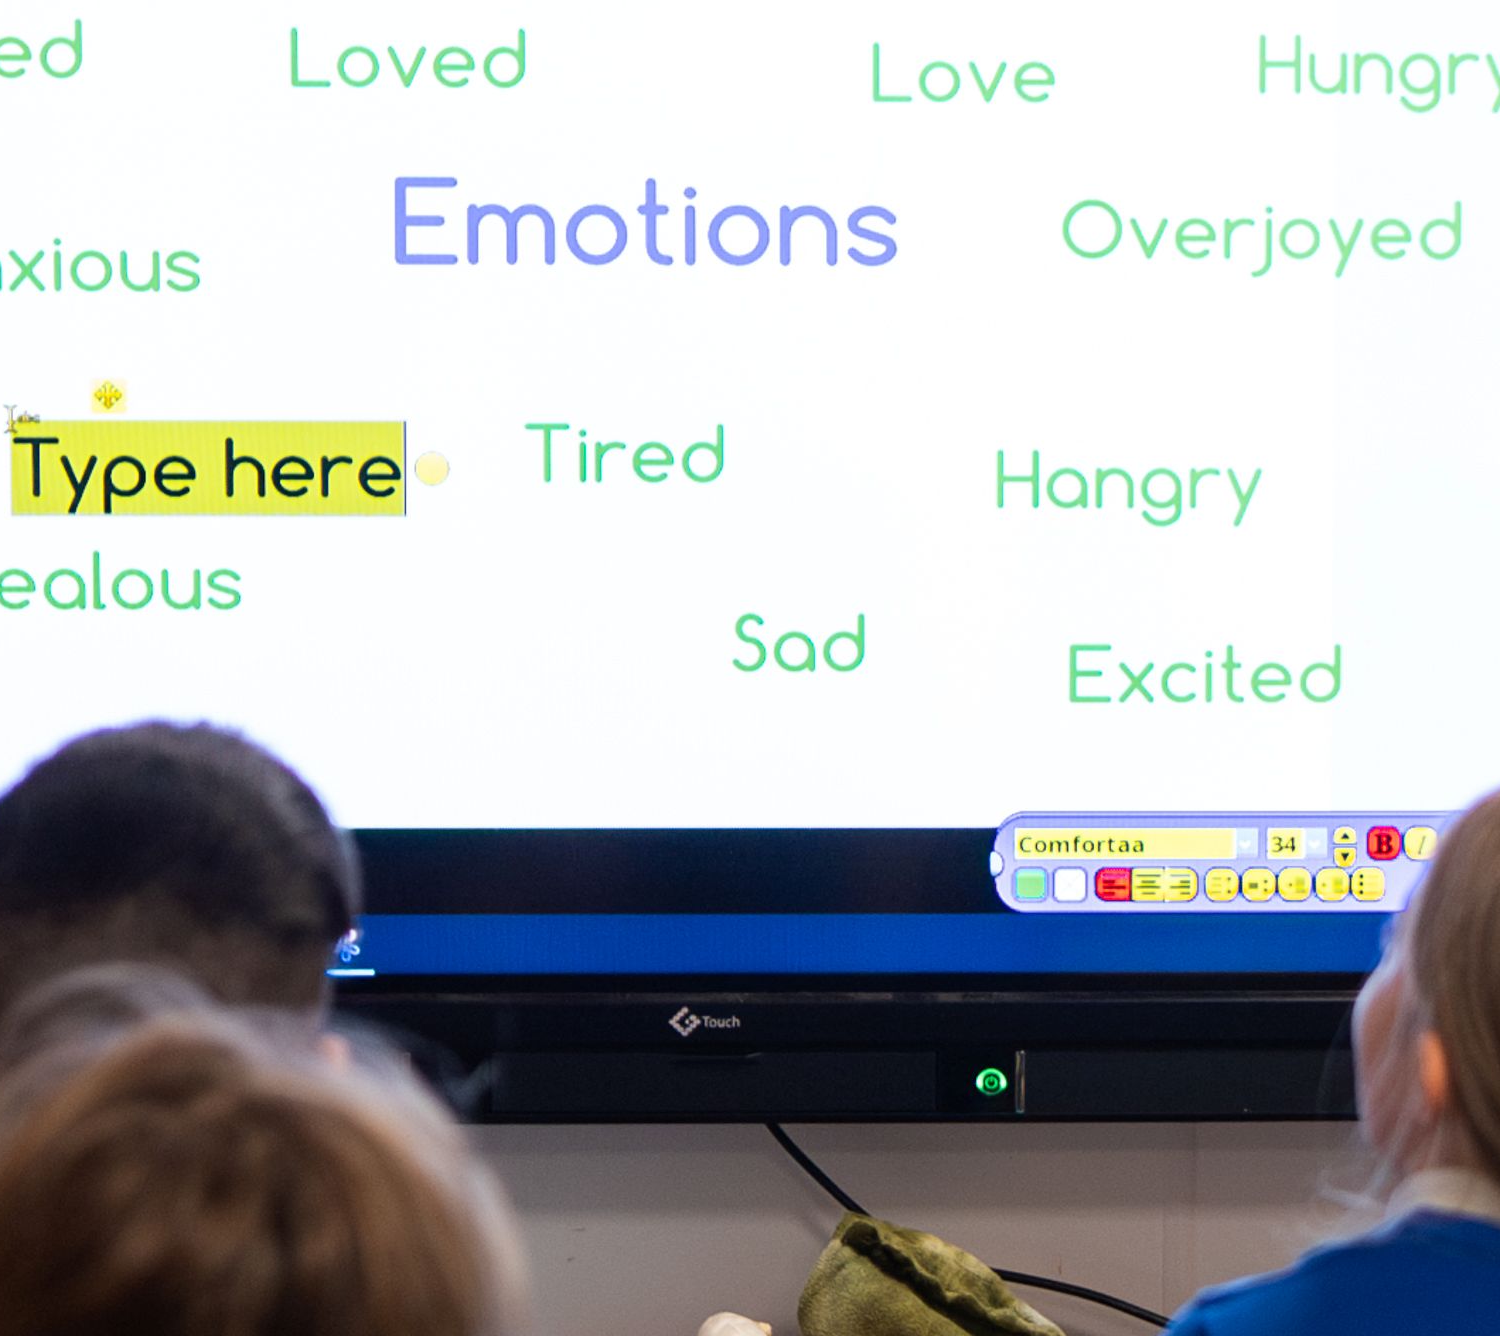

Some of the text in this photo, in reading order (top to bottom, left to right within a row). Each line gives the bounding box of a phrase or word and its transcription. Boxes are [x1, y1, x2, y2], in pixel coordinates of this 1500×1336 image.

[290, 26, 527, 88] Loved
[872, 42, 1056, 103] Love
[393, 176, 899, 266] Emotions
[1061, 198, 1463, 278] Overjoyed
[12, 436, 402, 515] Type here
[524, 421, 725, 484] Tired
[996, 449, 1262, 527] Hangry
[731, 612, 866, 673] Sad
[1068, 644, 1342, 703] Excited
[1018, 835, 1297, 855] Comfortaa 34
[703, 1014, 741, 1030] Touch
